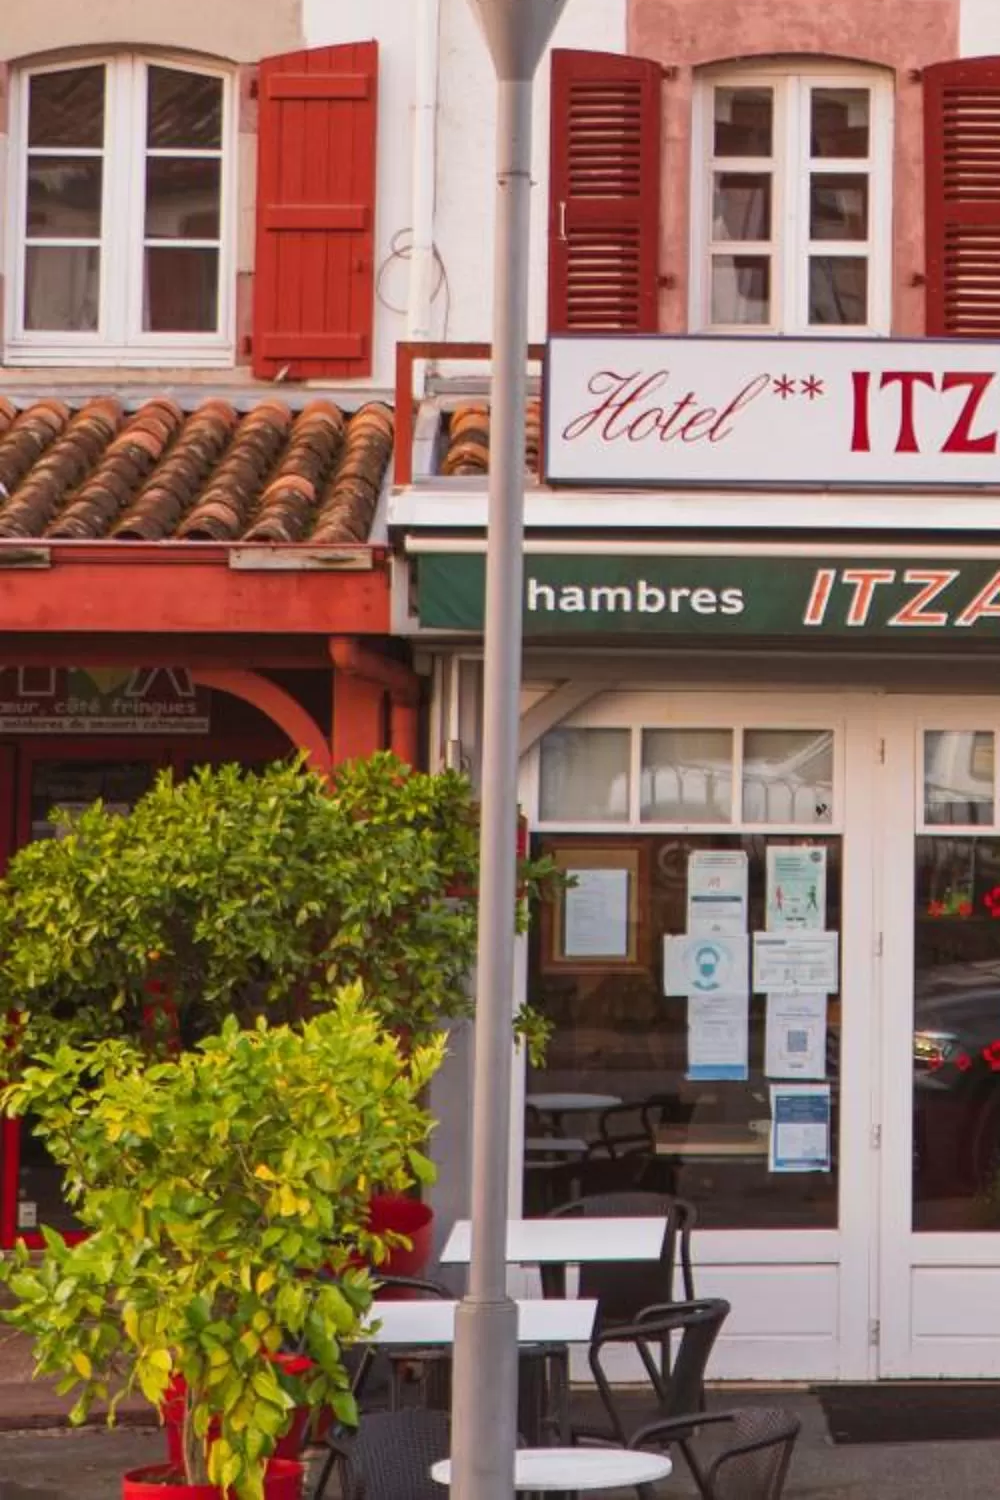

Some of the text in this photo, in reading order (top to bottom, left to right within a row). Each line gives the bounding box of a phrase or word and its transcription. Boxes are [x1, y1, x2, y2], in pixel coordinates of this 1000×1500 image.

[561, 370, 772, 444] Hotel
[527, 578, 744, 615] hambres
[112, 698, 197, 717] fringues
